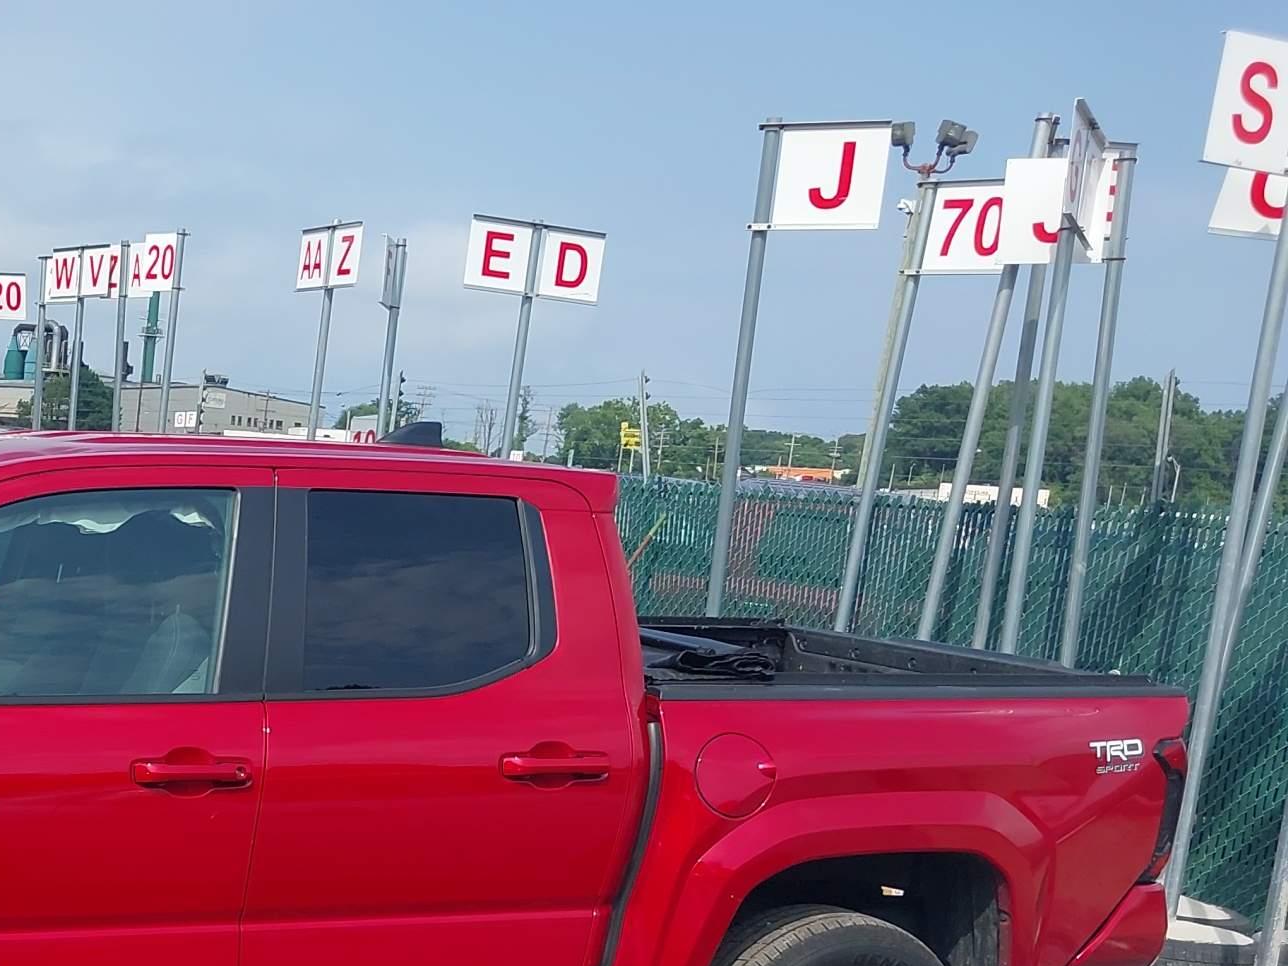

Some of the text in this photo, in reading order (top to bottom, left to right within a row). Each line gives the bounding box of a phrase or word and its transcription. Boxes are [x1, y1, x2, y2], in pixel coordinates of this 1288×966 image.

[1231, 61, 1278, 145] S
[808, 141, 856, 210] J
[939, 196, 1003, 258] 70
[55, 256, 75, 290] W
[89, 254, 104, 288] V
[145, 244, 174, 280] 20
[300, 239, 322, 281] AA
[336, 234, 355, 277] Z
[481, 230, 515, 279] E
[554, 241, 588, 289] D
[1089, 739, 1143, 762] TRD
[1096, 763, 1141, 774] SPORT
